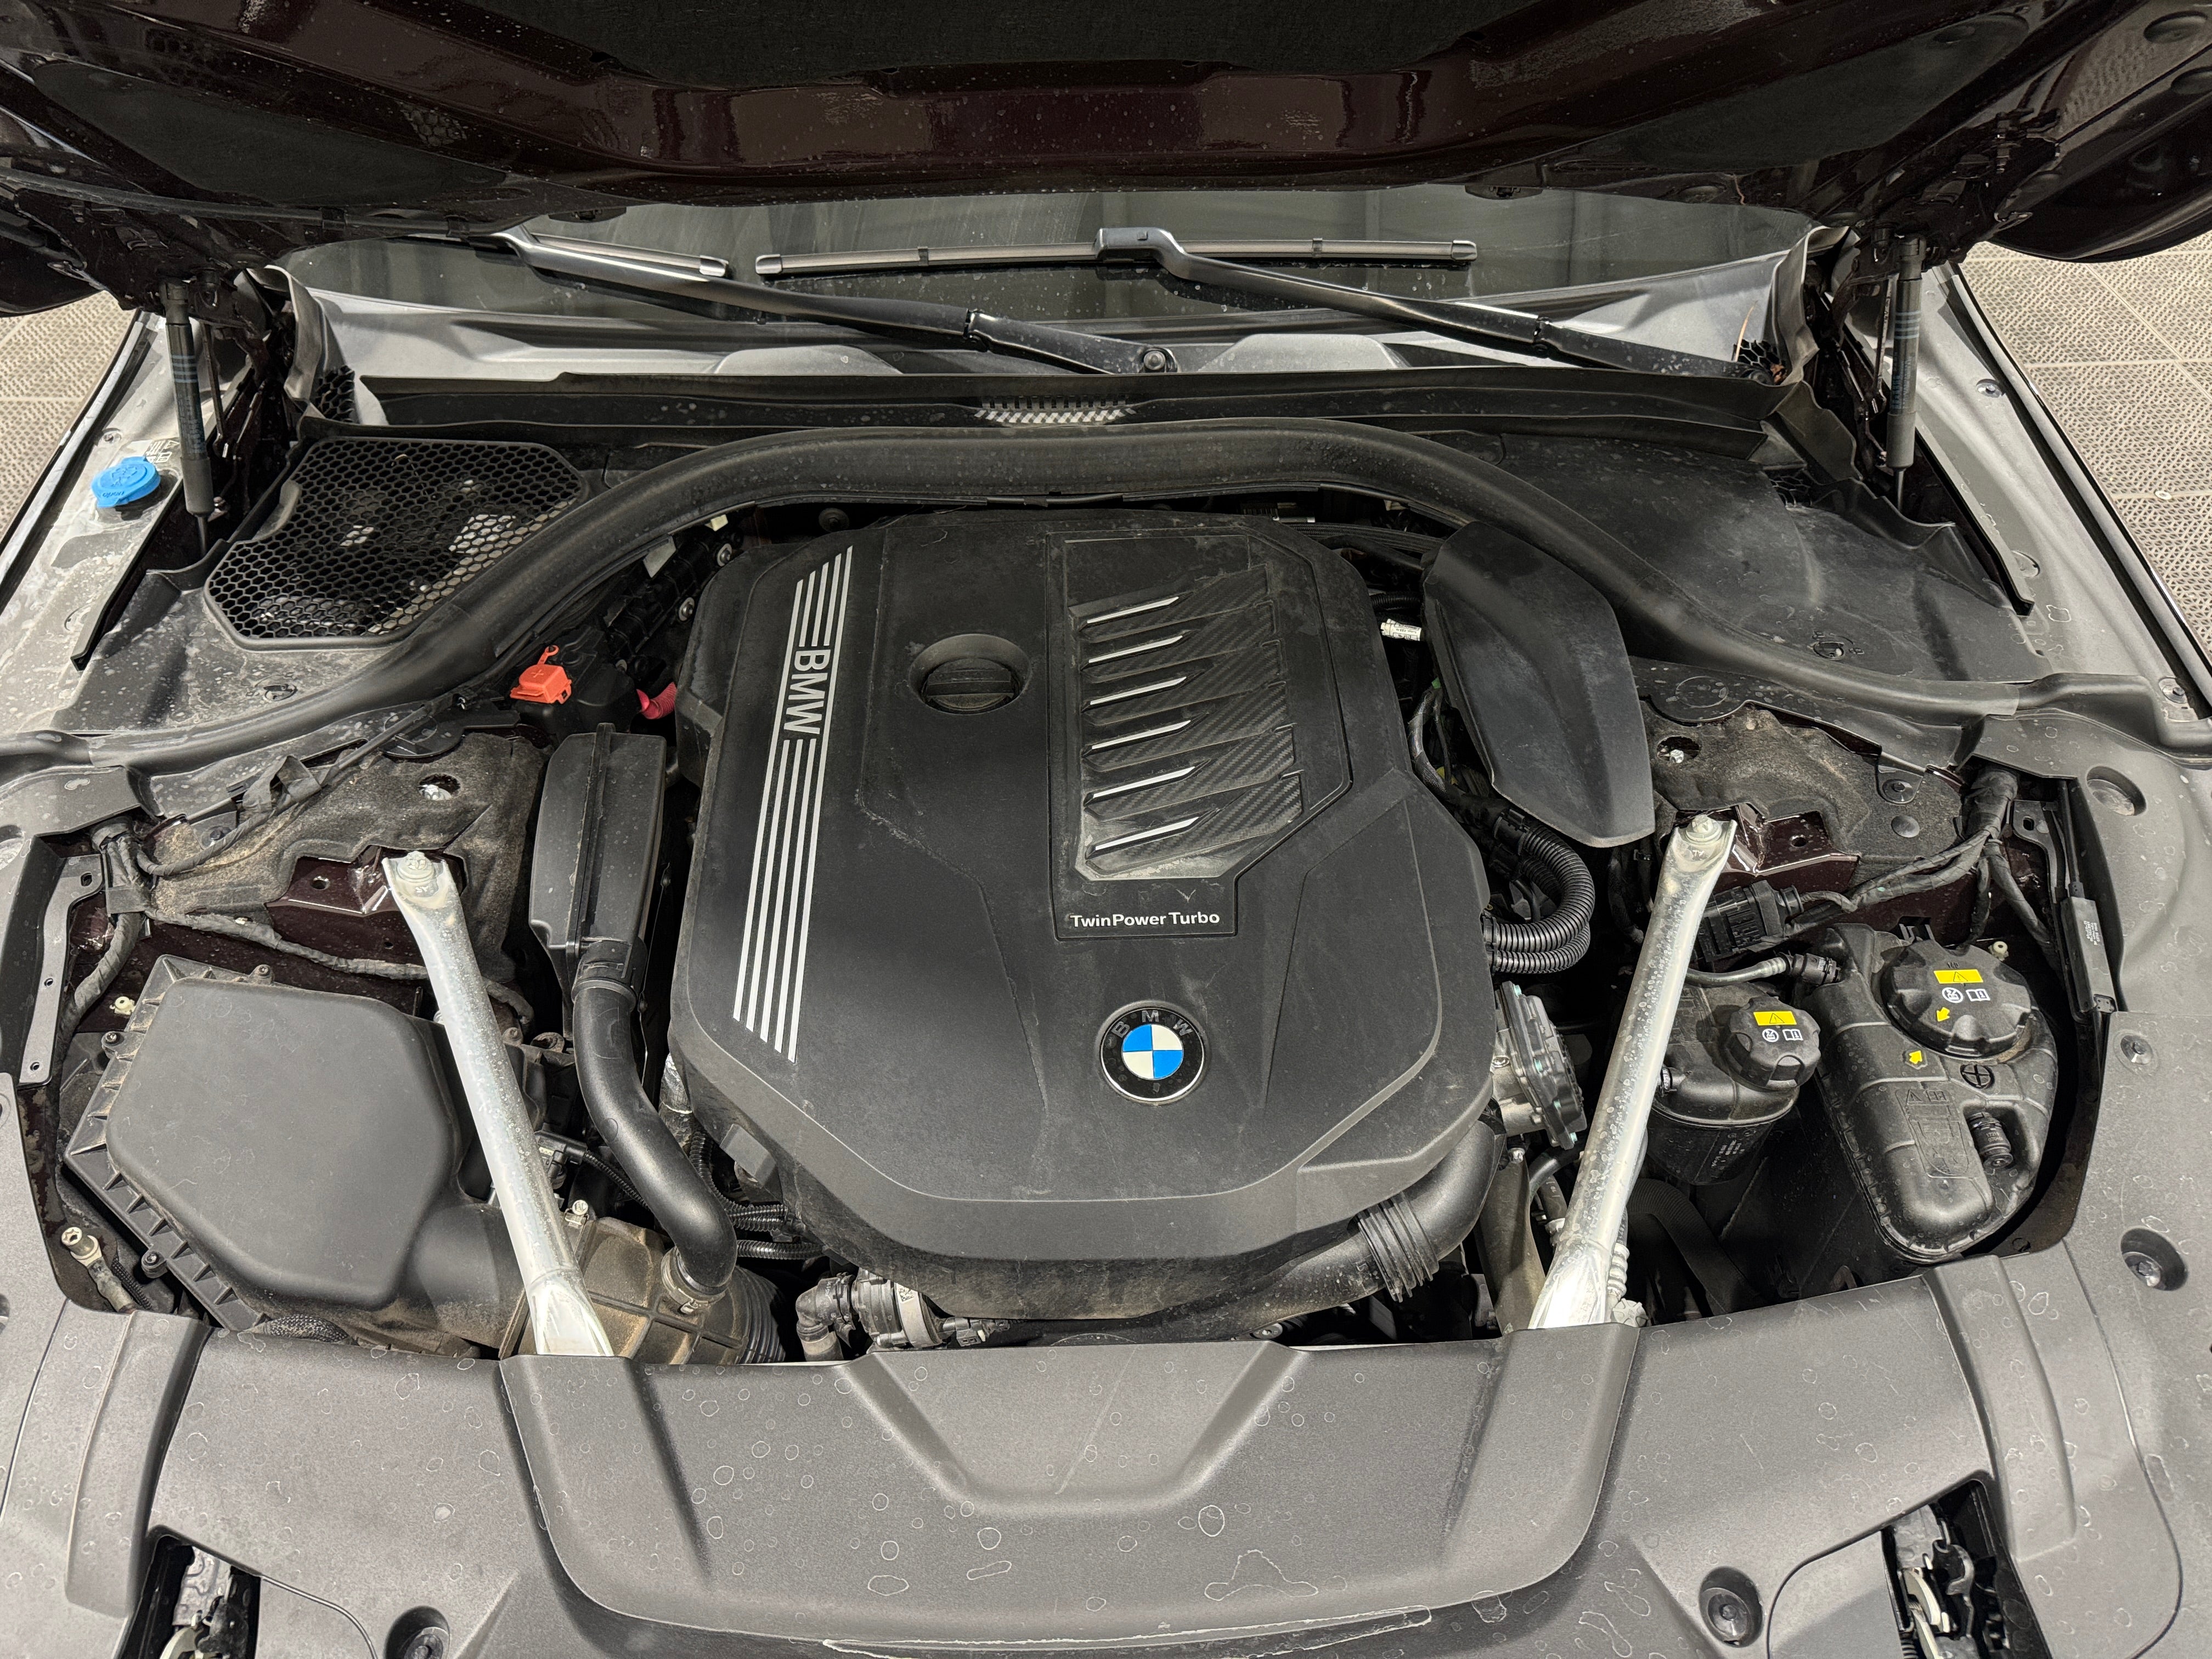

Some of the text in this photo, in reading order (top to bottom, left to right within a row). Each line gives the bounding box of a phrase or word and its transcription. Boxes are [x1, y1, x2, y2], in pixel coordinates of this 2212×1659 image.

[783, 649, 831, 735] BMW
[1070, 912, 1220, 927] TwinPower Turbo
[1111, 1009, 1193, 1038] BMW
